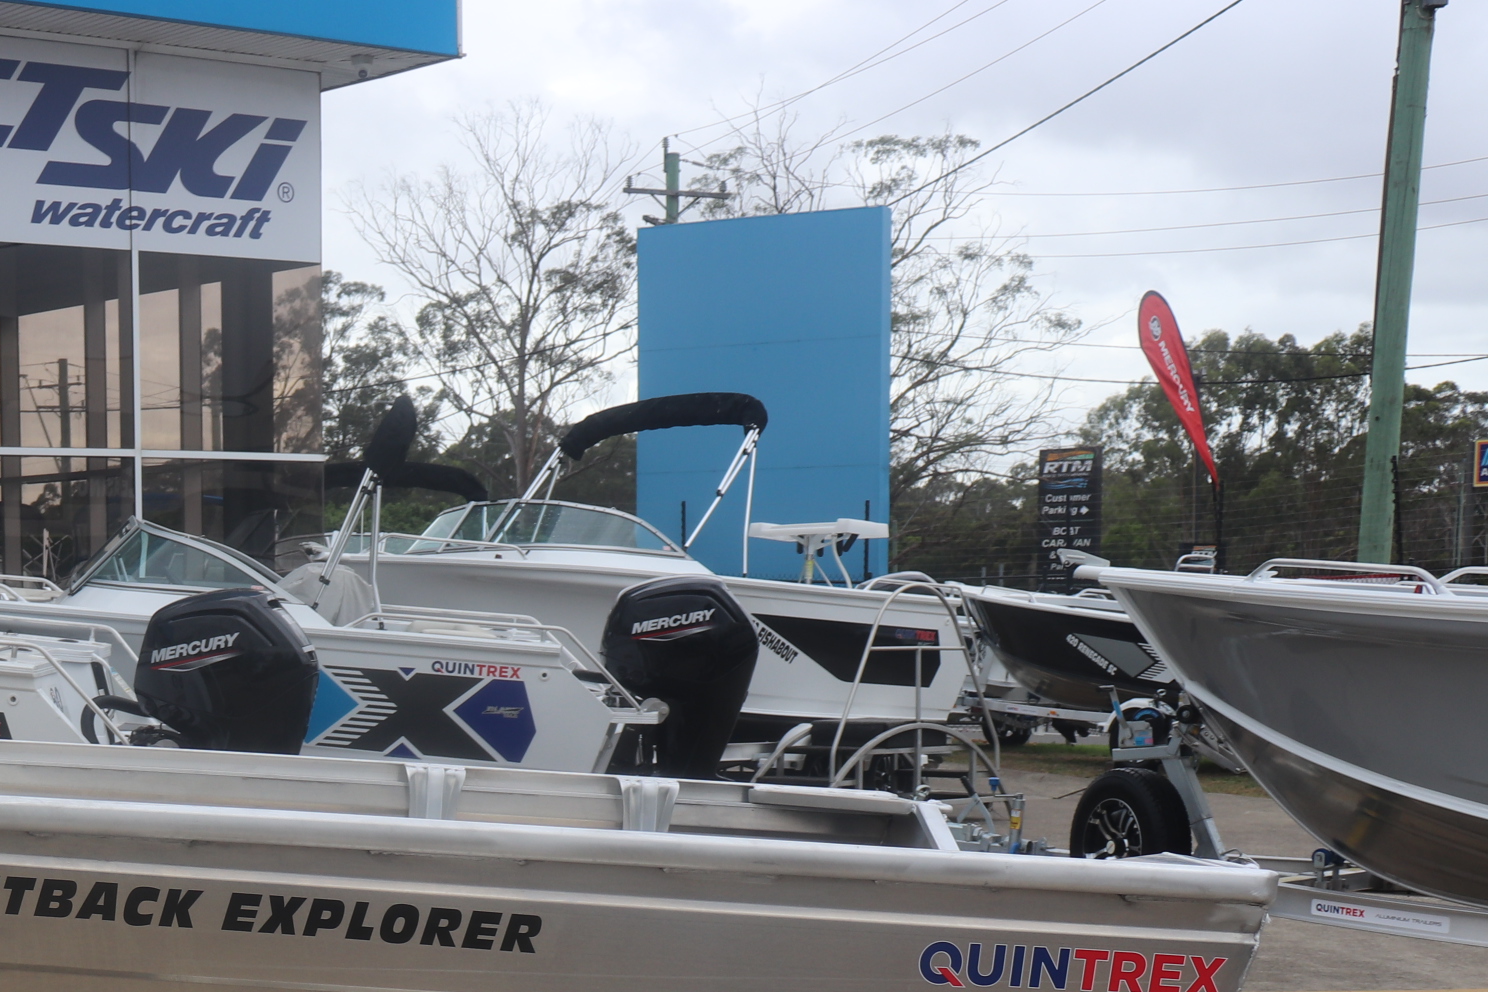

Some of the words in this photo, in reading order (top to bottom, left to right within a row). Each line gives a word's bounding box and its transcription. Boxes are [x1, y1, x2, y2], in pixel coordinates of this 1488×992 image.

[30, 198, 272, 240] watercraft
[1158, 340, 1195, 412] MERCURY
[1043, 460, 1093, 473] RTM
[1042, 506, 1078, 515] Parkig
[1045, 494, 1091, 502] Custmer
[631, 608, 715, 635] MERCURY
[150, 632, 240, 664] MERCURY
[758, 627, 799, 664] FISHABOUT
[431, 661, 521, 680] QUINTREX
[220, 893, 543, 953] EXPLORER
[1316, 904, 1365, 918] QUINTREX
